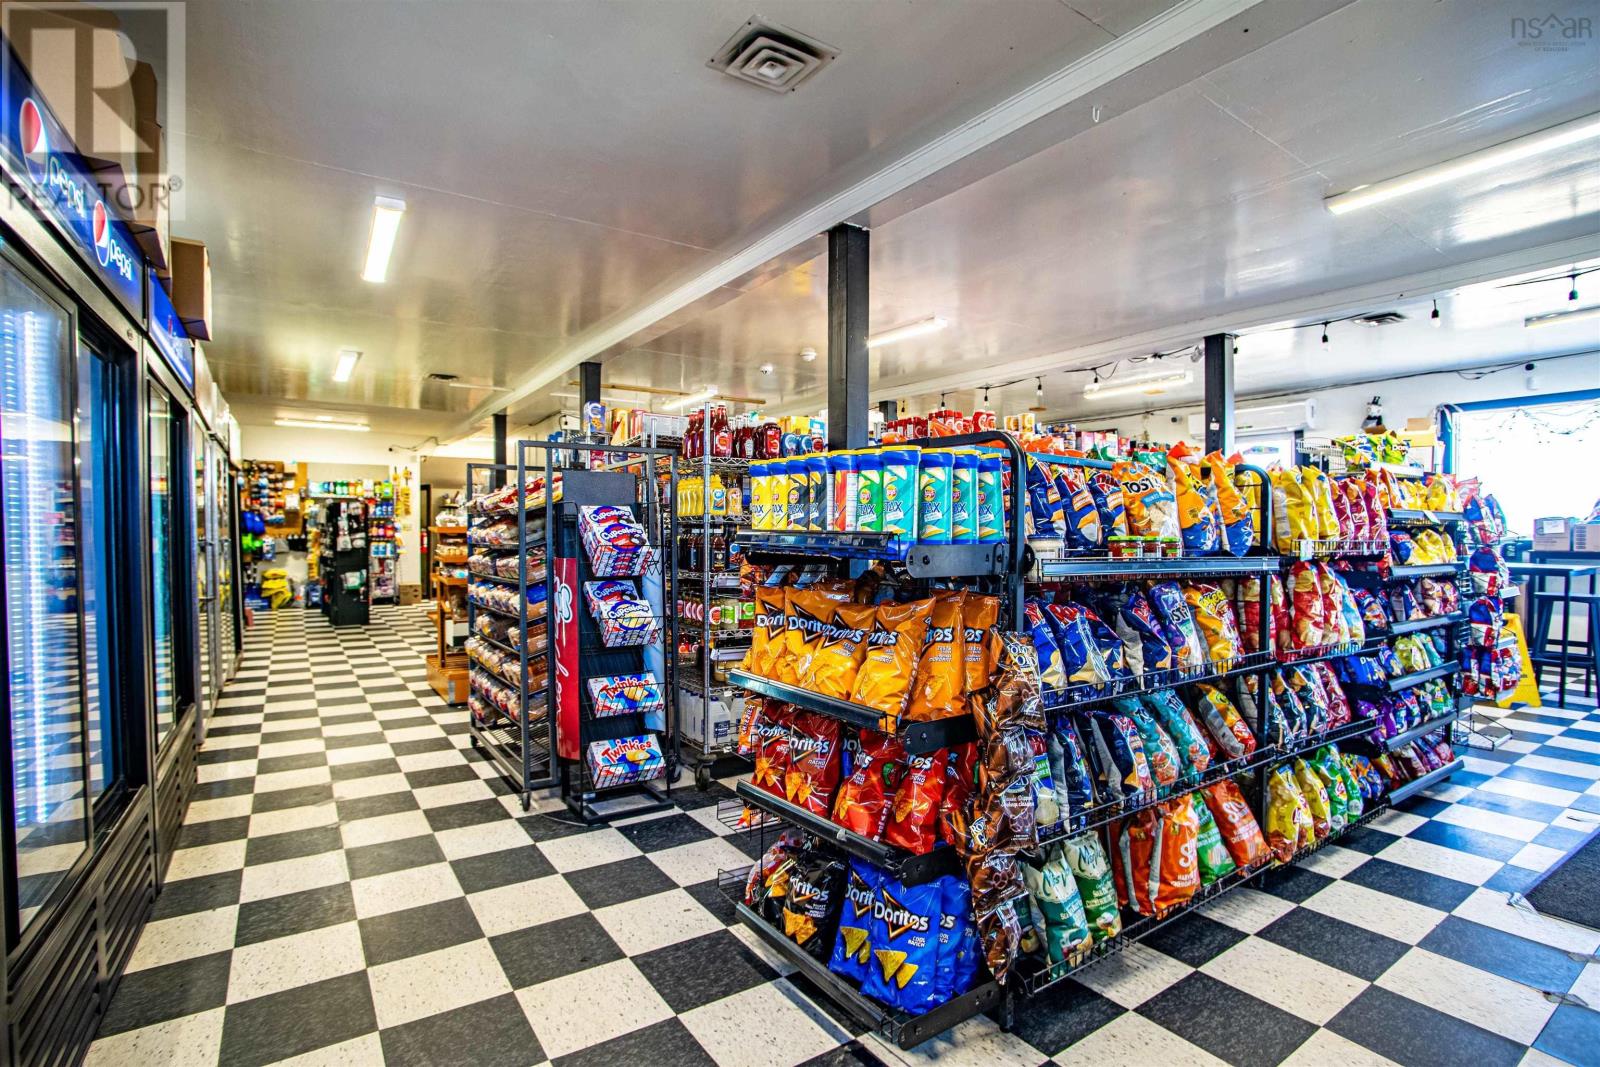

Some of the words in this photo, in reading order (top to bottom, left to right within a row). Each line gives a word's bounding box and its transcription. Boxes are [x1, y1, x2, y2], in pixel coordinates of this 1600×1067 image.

[109, 239, 133, 281] pepsi
[601, 528, 644, 541] Cupcakes
[600, 676, 650, 700] Twinkies
[601, 740, 652, 764] Twinkies
[874, 900, 930, 932] Doritos
